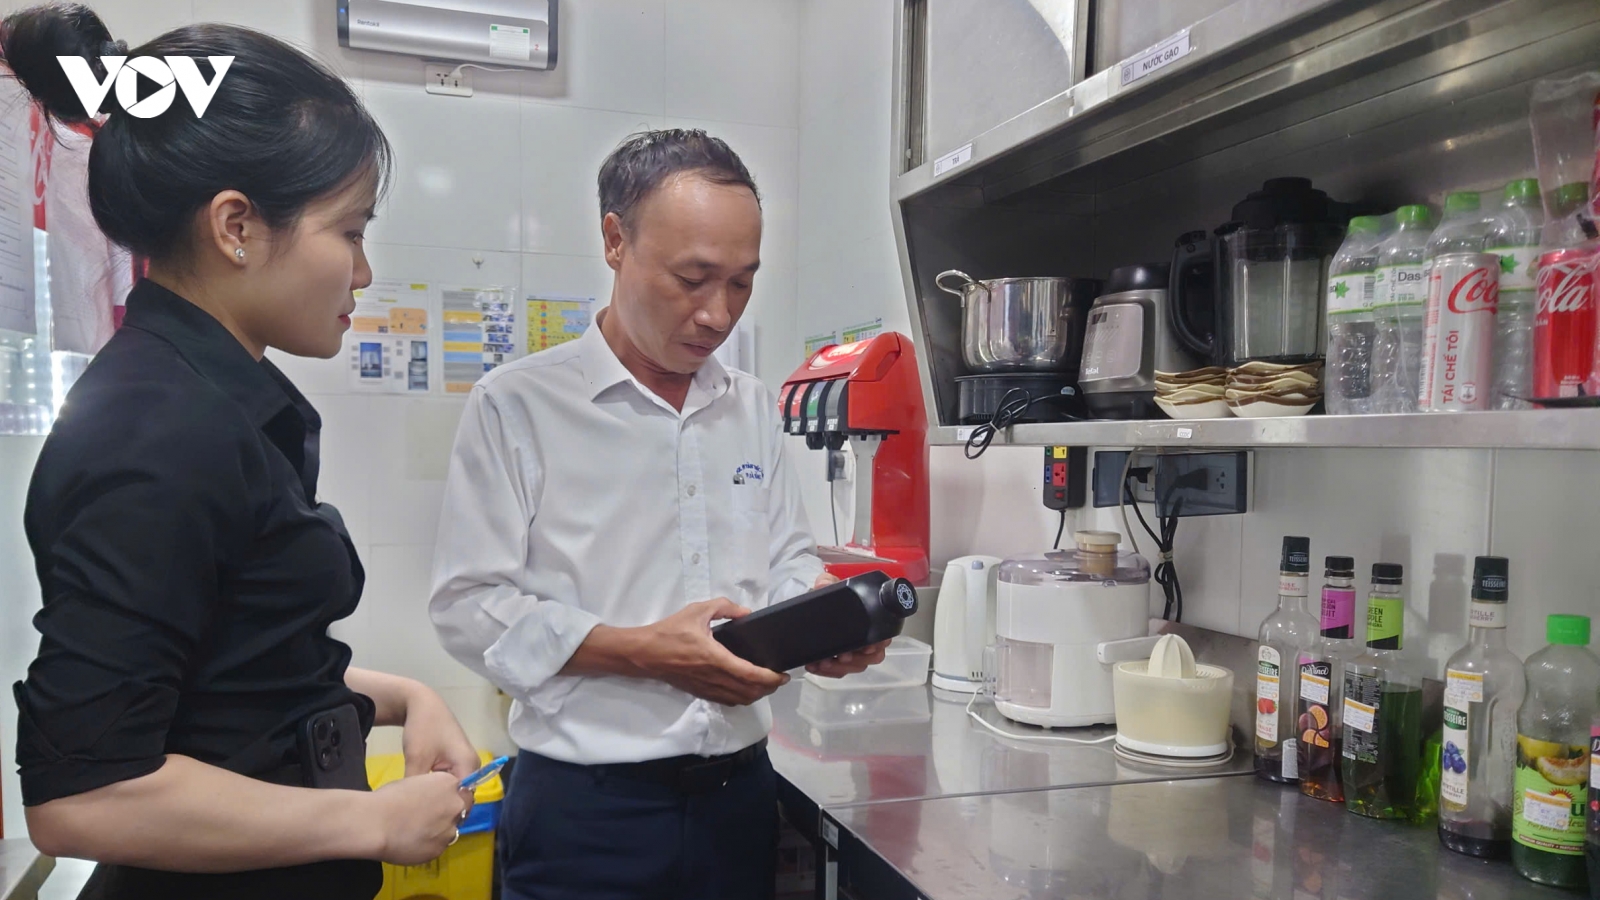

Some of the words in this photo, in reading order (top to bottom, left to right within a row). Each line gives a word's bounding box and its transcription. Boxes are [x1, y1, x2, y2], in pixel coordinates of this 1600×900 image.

[1143, 54, 1163, 71] NƯỚC
[1164, 46, 1179, 60] GẠO
[1446, 330, 1459, 351] TÔI
[1443, 354, 1457, 381] CHẾ
[1441, 384, 1455, 404] TÁI
